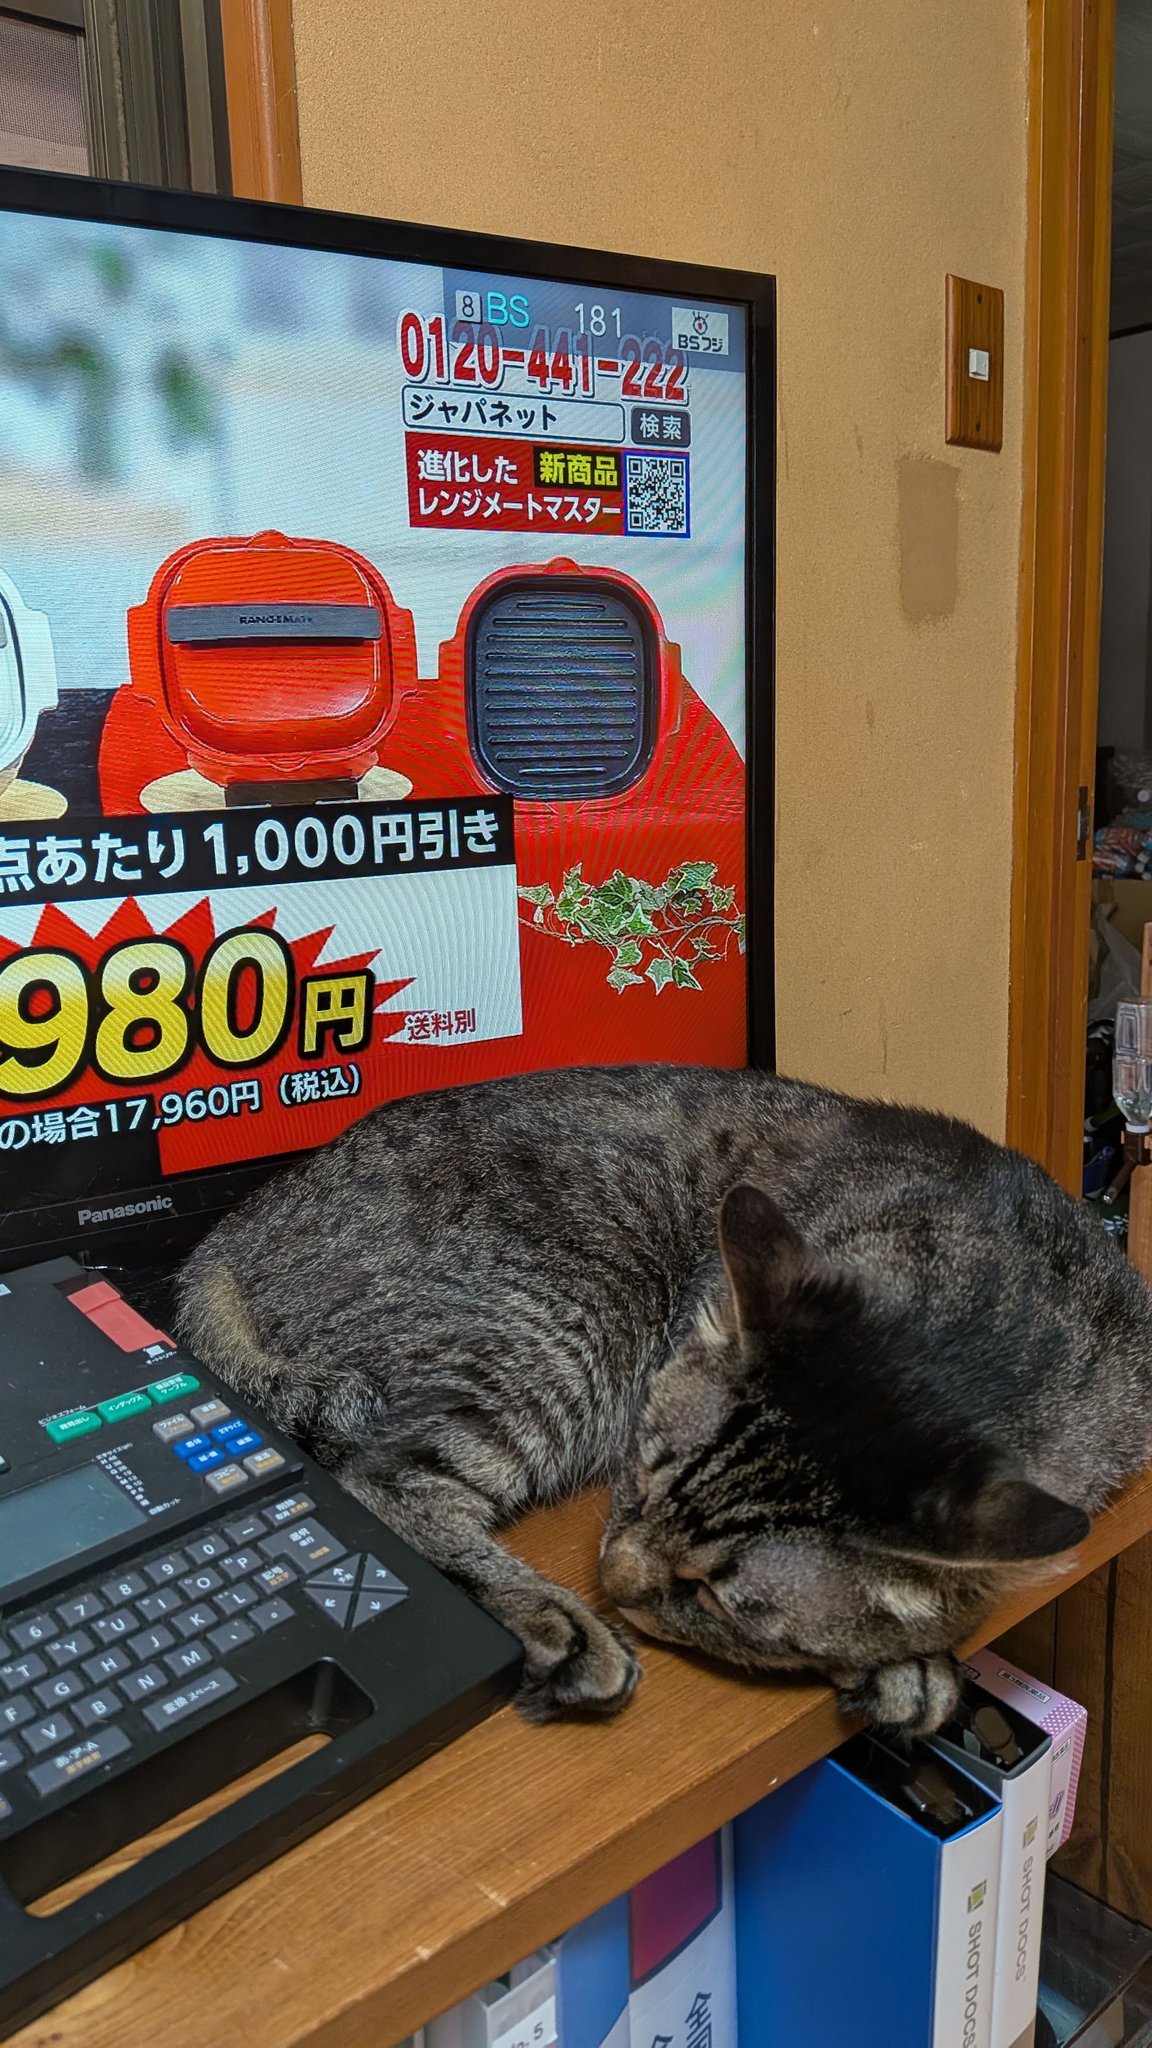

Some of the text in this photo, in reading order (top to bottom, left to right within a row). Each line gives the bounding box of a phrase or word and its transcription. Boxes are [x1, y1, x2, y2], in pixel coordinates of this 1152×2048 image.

[461, 293, 622, 337] 8 BS 181
[677, 335, 724, 353] BSフジ
[399, 310, 688, 401] 0120-441-222
[410, 393, 557, 431] ジャパネット
[639, 413, 683, 441] 検索
[417, 449, 518, 485] 進化した
[539, 451, 619, 486] 新商品
[418, 487, 622, 522] レンジメートマスター
[406, 1008, 477, 1041] 送料別
[78, 1195, 173, 1226] Panasonic
[107, 1395, 143, 1412] インデックス
[38, 1404, 87, 1425] ビジネスフォーム
[160, 1416, 184, 1429] ファイル
[214, 1466, 236, 1480] コピー
[161, 1563, 174, 1575] 9
[237, 1557, 248, 1569] P
[261, 1565, 283, 1581] 記号
[119, 1584, 132, 1595] 8
[232, 1593, 246, 1604] L
[74, 1604, 85, 1616] 7
[110, 1618, 125, 1631] U
[189, 1613, 205, 1627] K
[29, 1626, 42, 1638] 6
[64, 1640, 78, 1653] Y
[151, 1635, 160, 1648] J
[100, 1657, 118, 1672] H
[181, 1650, 201, 1666] M
[16, 1664, 30, 1678] T
[53, 1682, 71, 1696] G
[137, 1674, 155, 1690] N
[162, 1679, 220, 1715] 変換 スペース
[4, 1707, 17, 1722] F
[90, 1701, 108, 1715] B
[41, 1724, 57, 1740] V
[1015, 1855, 1034, 1982] SHOT DOCS
[962, 1920, 983, 2048] SHOT DOCS
[533, 2021, 544, 2040] 5
